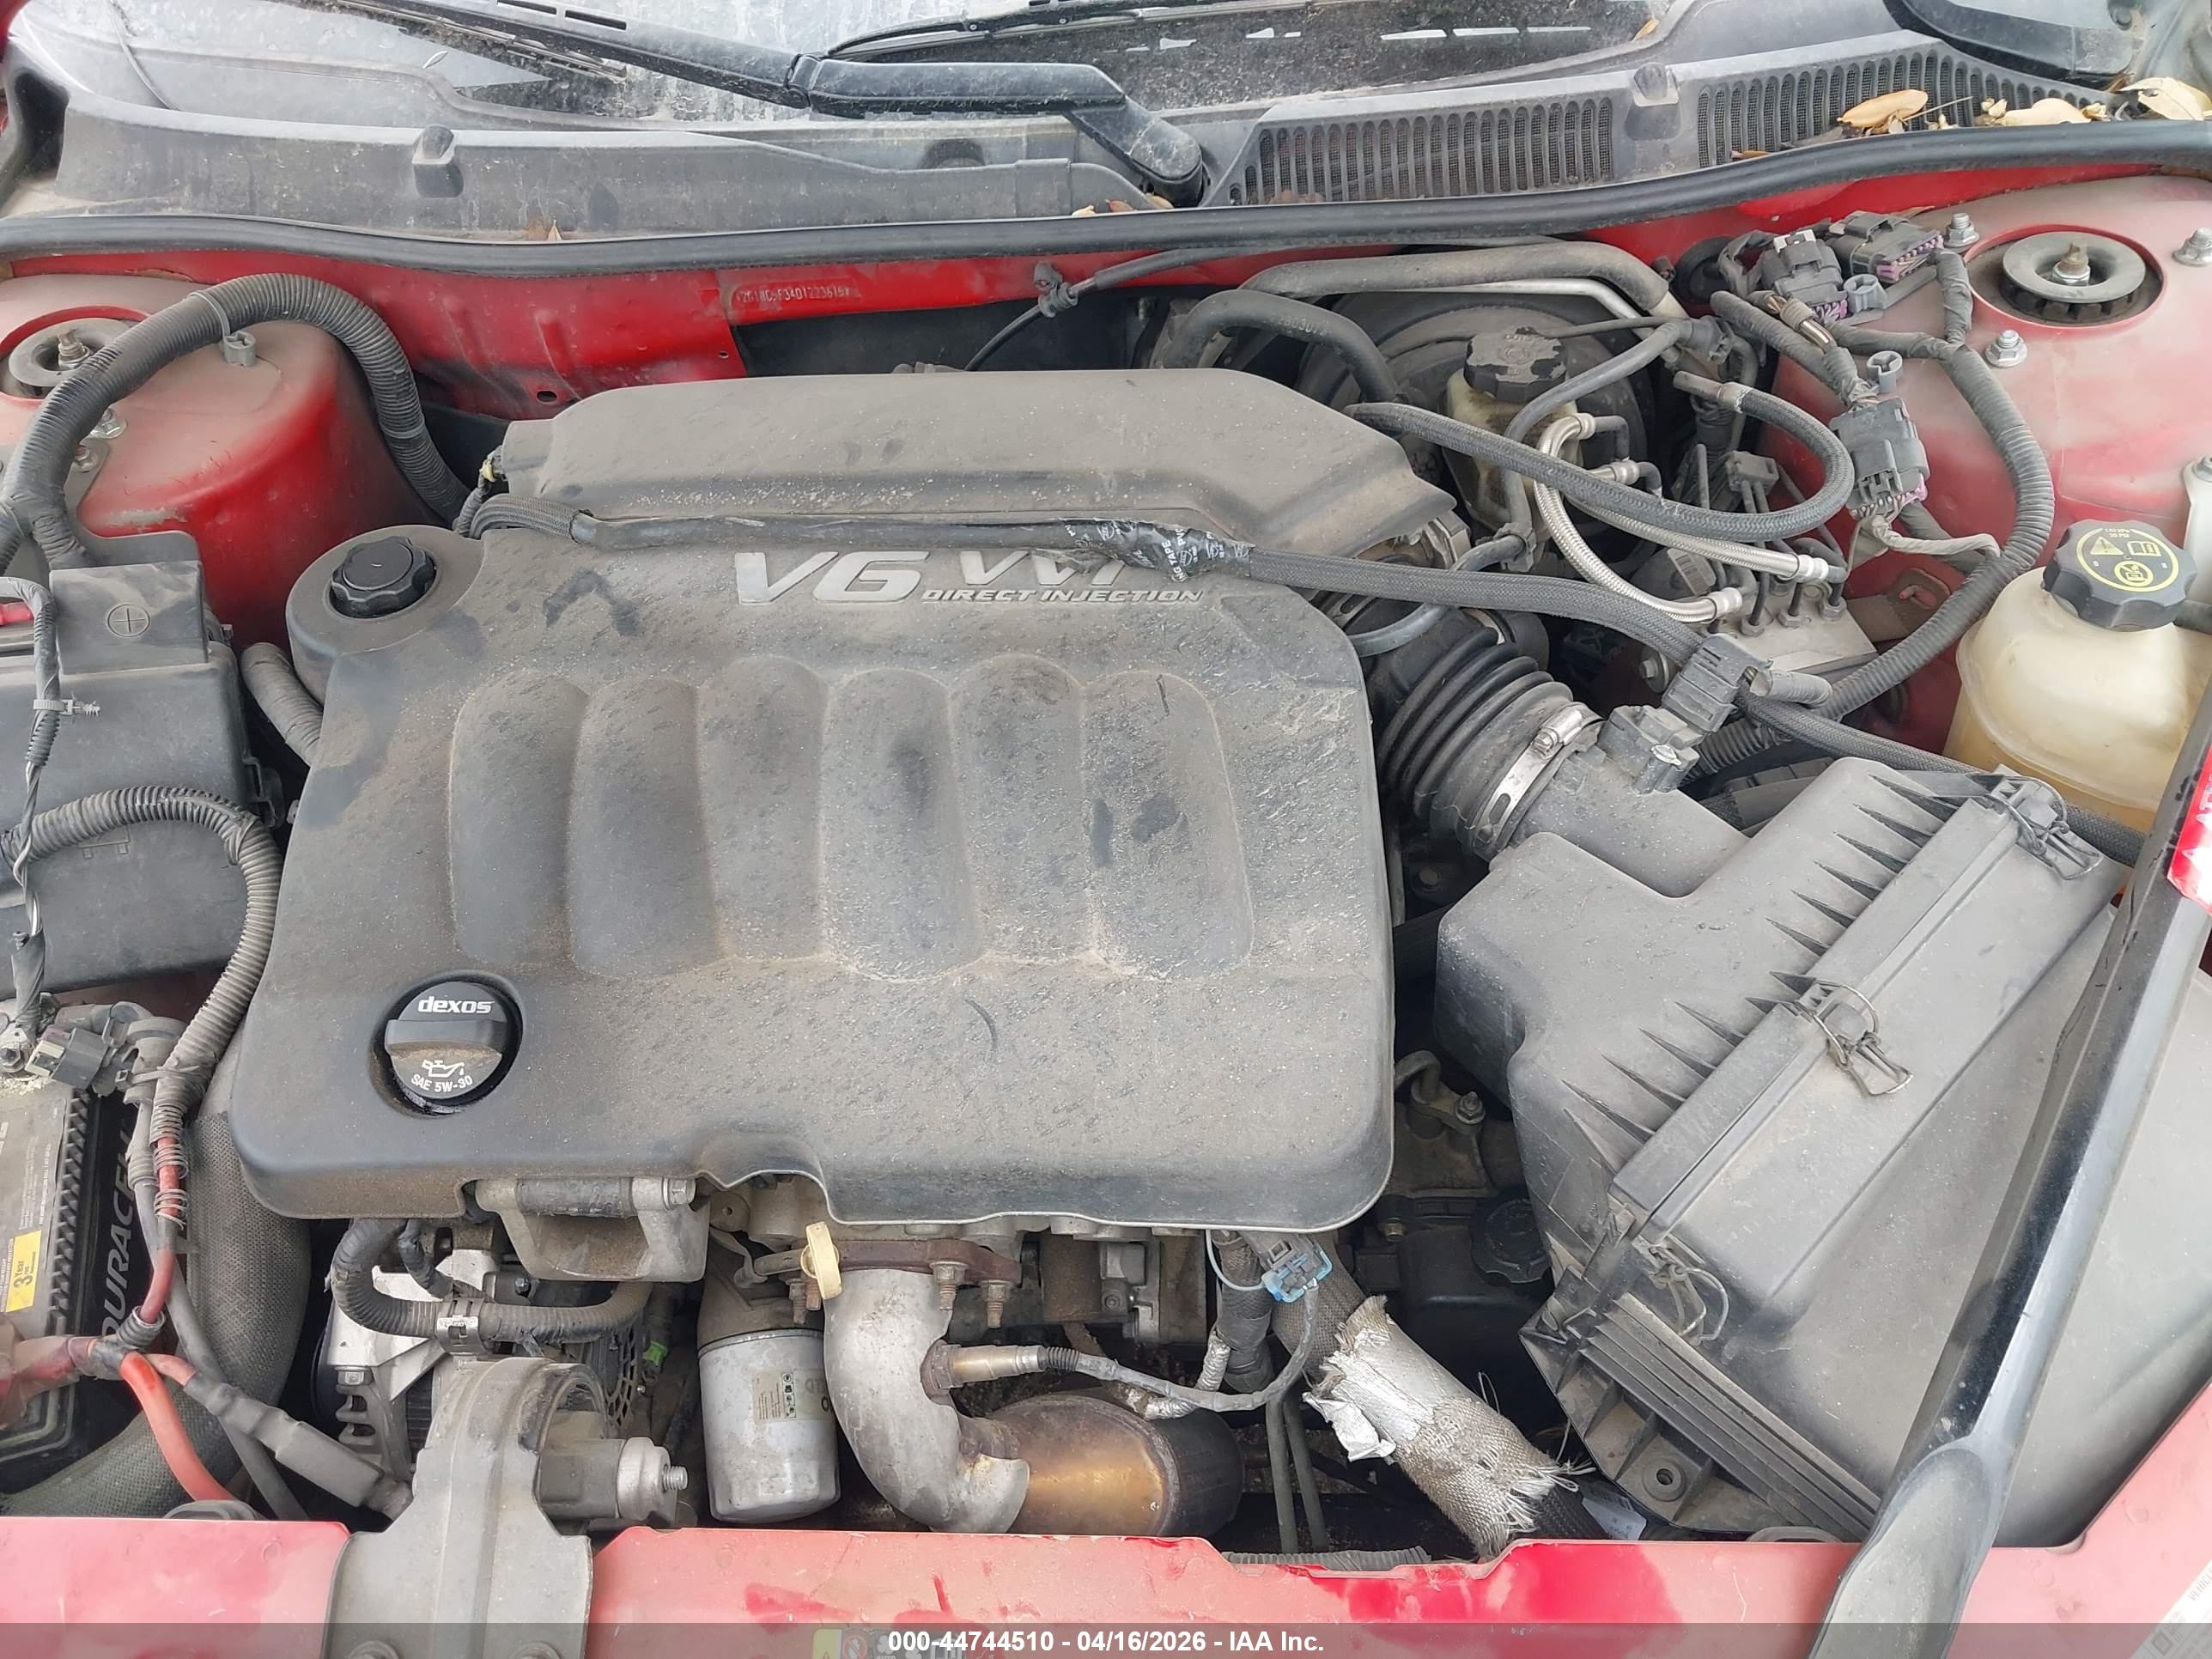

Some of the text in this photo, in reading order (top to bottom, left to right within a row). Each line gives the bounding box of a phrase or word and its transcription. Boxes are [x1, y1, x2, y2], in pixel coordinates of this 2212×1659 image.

[1161, 540, 1178, 566] TAPE
[735, 551, 930, 605] V6
[921, 590, 1204, 603] DIRECT INJECTION
[417, 996, 495, 1013] dexos
[410, 1073, 473, 1093] SAE 5W-30
[15, 1261, 24, 1277] Year
[14, 1275, 33, 1288] 3
